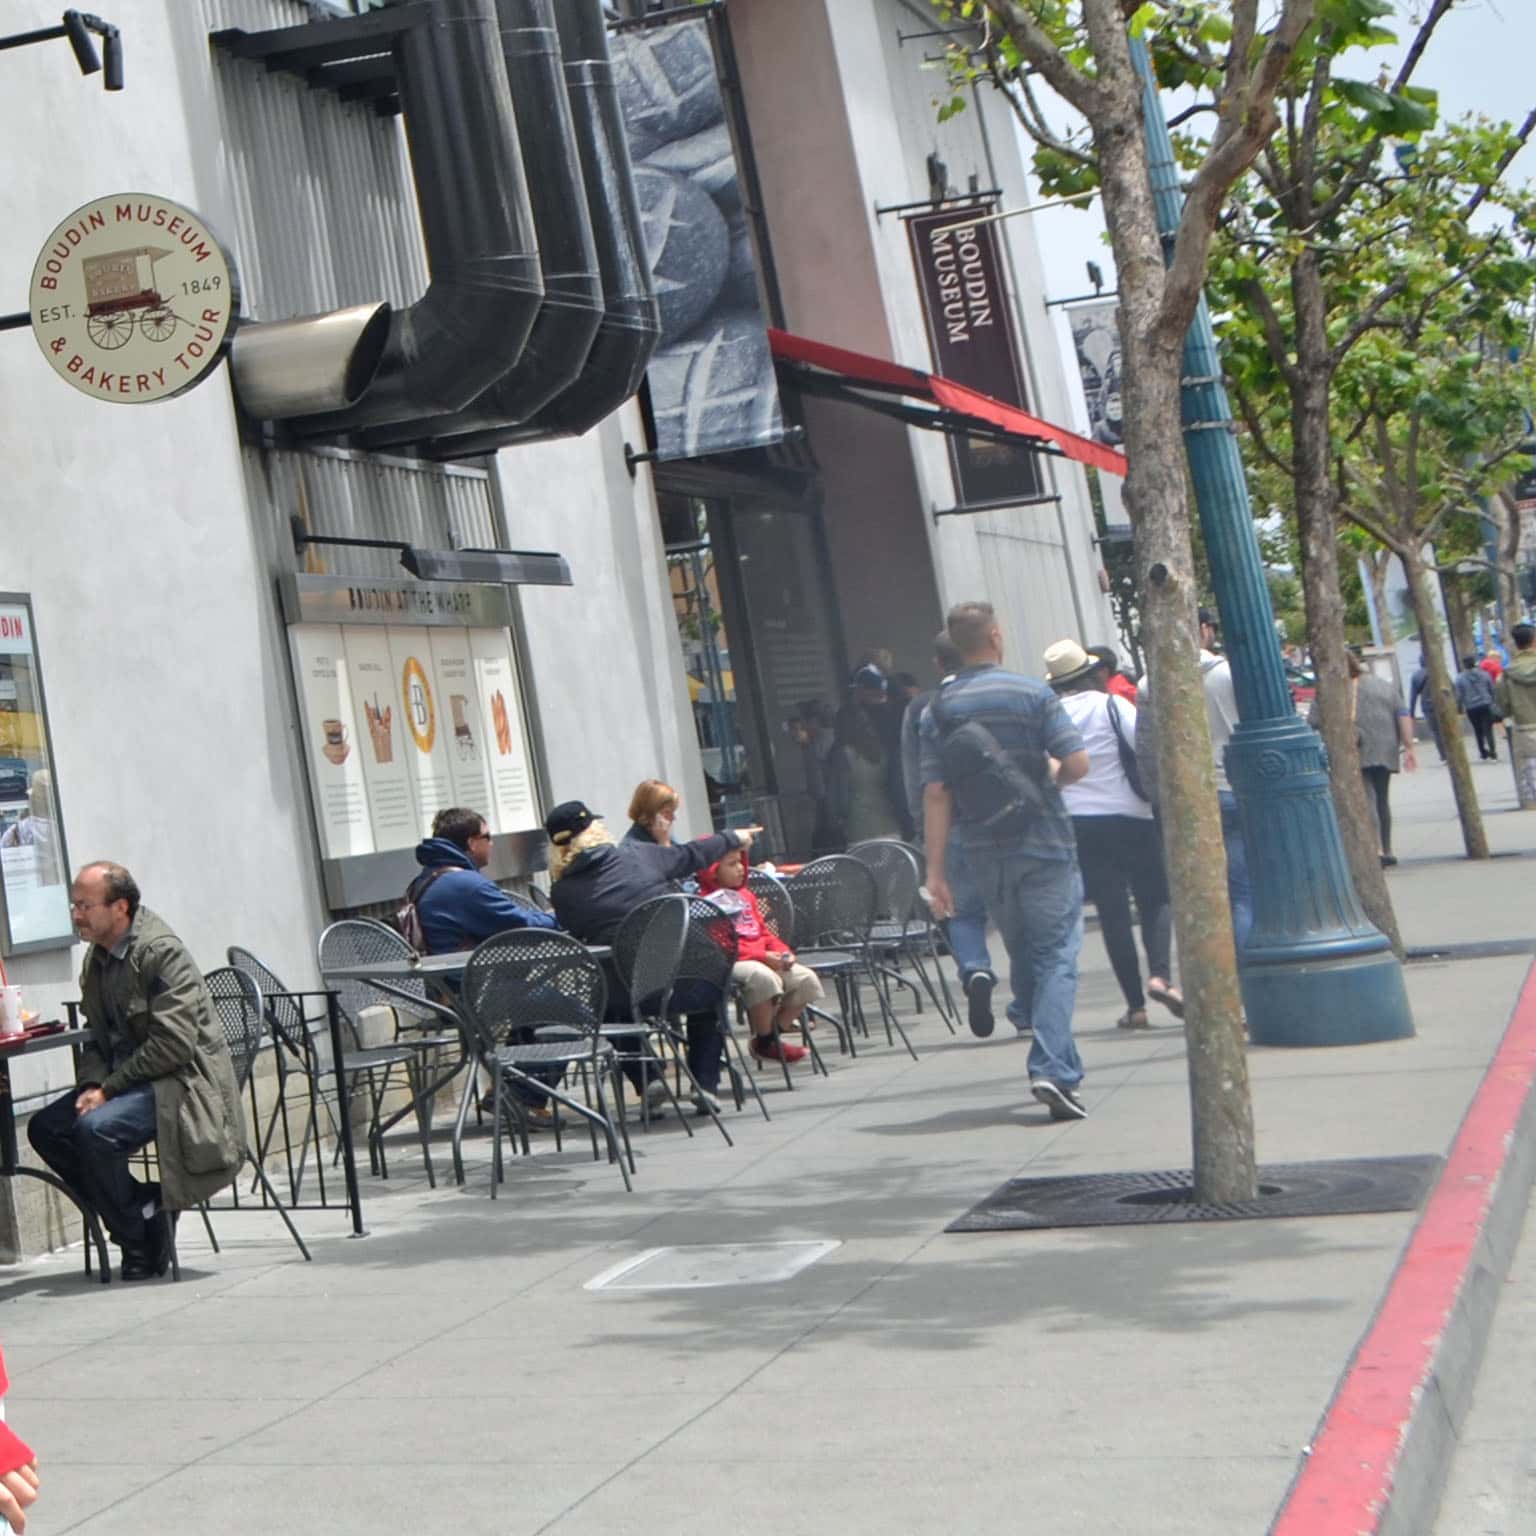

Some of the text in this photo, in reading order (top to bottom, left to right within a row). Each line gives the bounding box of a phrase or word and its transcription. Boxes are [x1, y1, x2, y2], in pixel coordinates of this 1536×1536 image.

[40, 204, 212, 290] BOUDIN MUSEUM
[182, 276, 221, 295] 1849
[930, 227, 969, 344] MUSEUM
[955, 225, 993, 327] BOUDIN
[40, 305, 76, 323] EST.
[50, 308, 221, 393] & BAKERY TOUR
